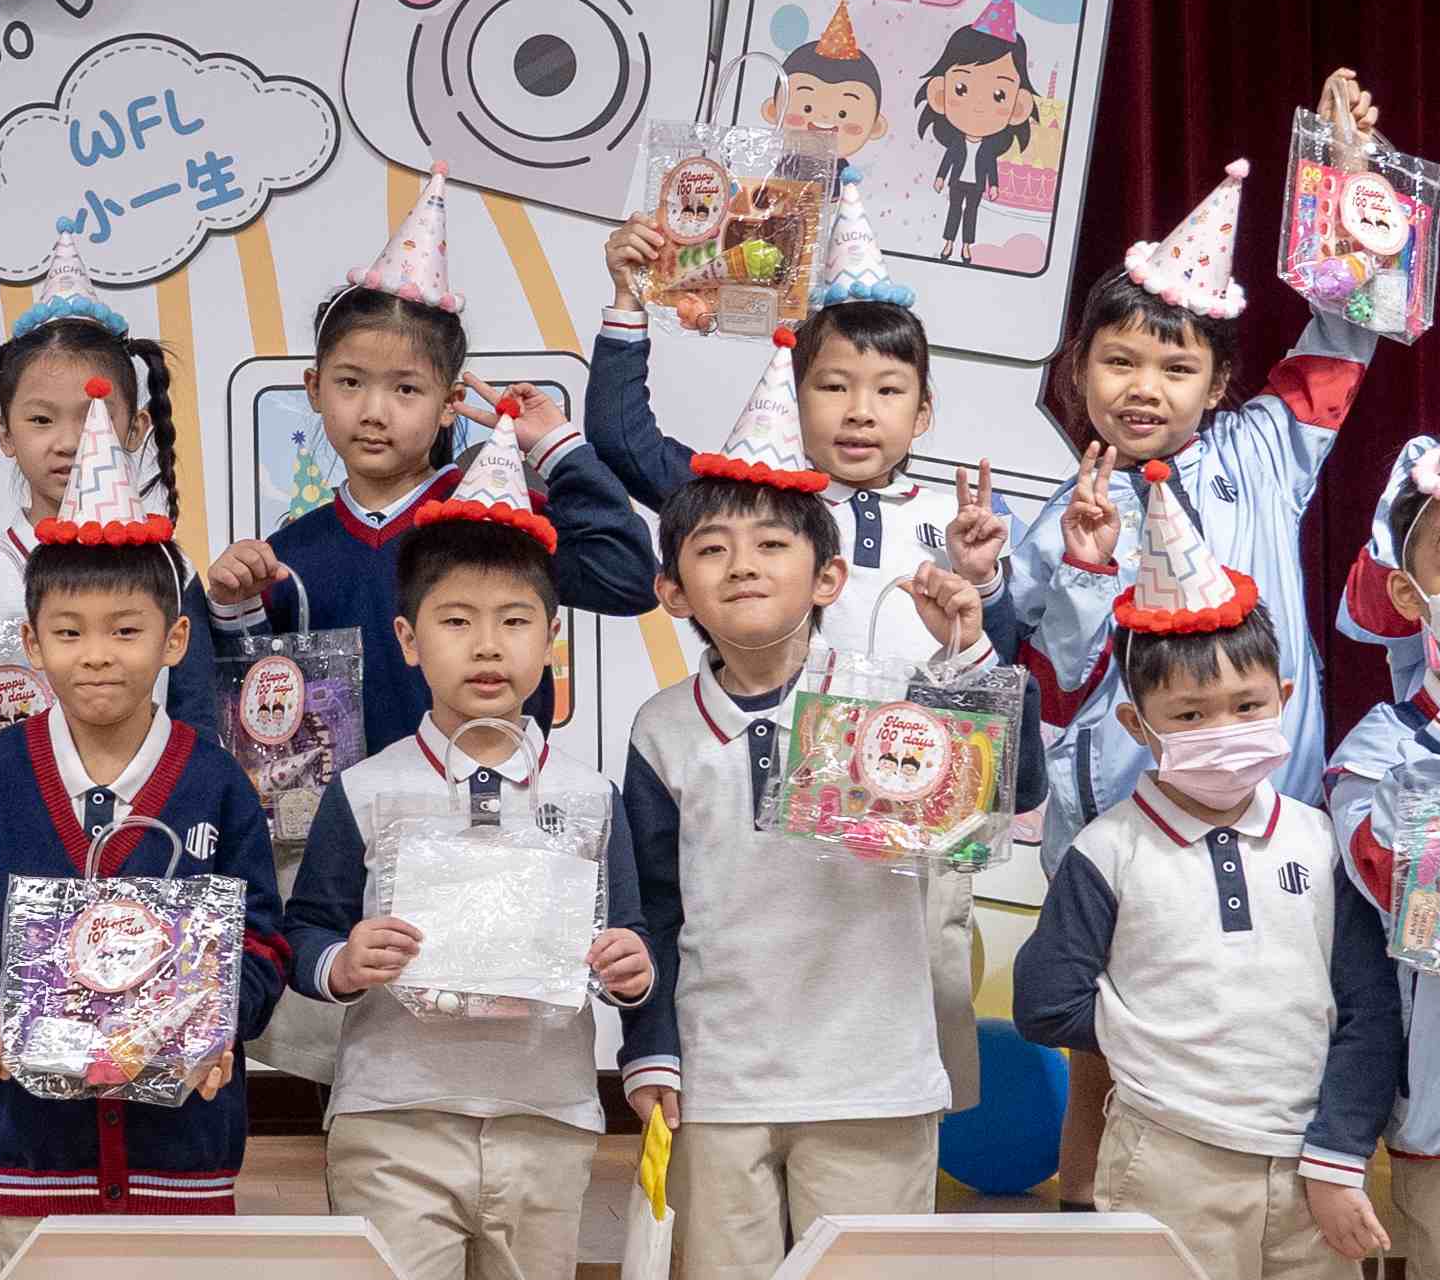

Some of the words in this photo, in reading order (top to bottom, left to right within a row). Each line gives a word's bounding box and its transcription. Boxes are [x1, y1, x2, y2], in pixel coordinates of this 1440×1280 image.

[68, 88, 205, 167] WFL
[679, 171, 714, 184] Happy
[72, 150, 245, 244] 小一生
[676, 184, 692, 196] 100
[694, 184, 720, 196] days
[259, 670, 290, 685] Happy
[7, 687, 37, 705] days
[273, 682, 294, 696] days
[883, 714, 929, 734] Happy
[874, 728, 899, 742] 100
[902, 732, 936, 750] days
